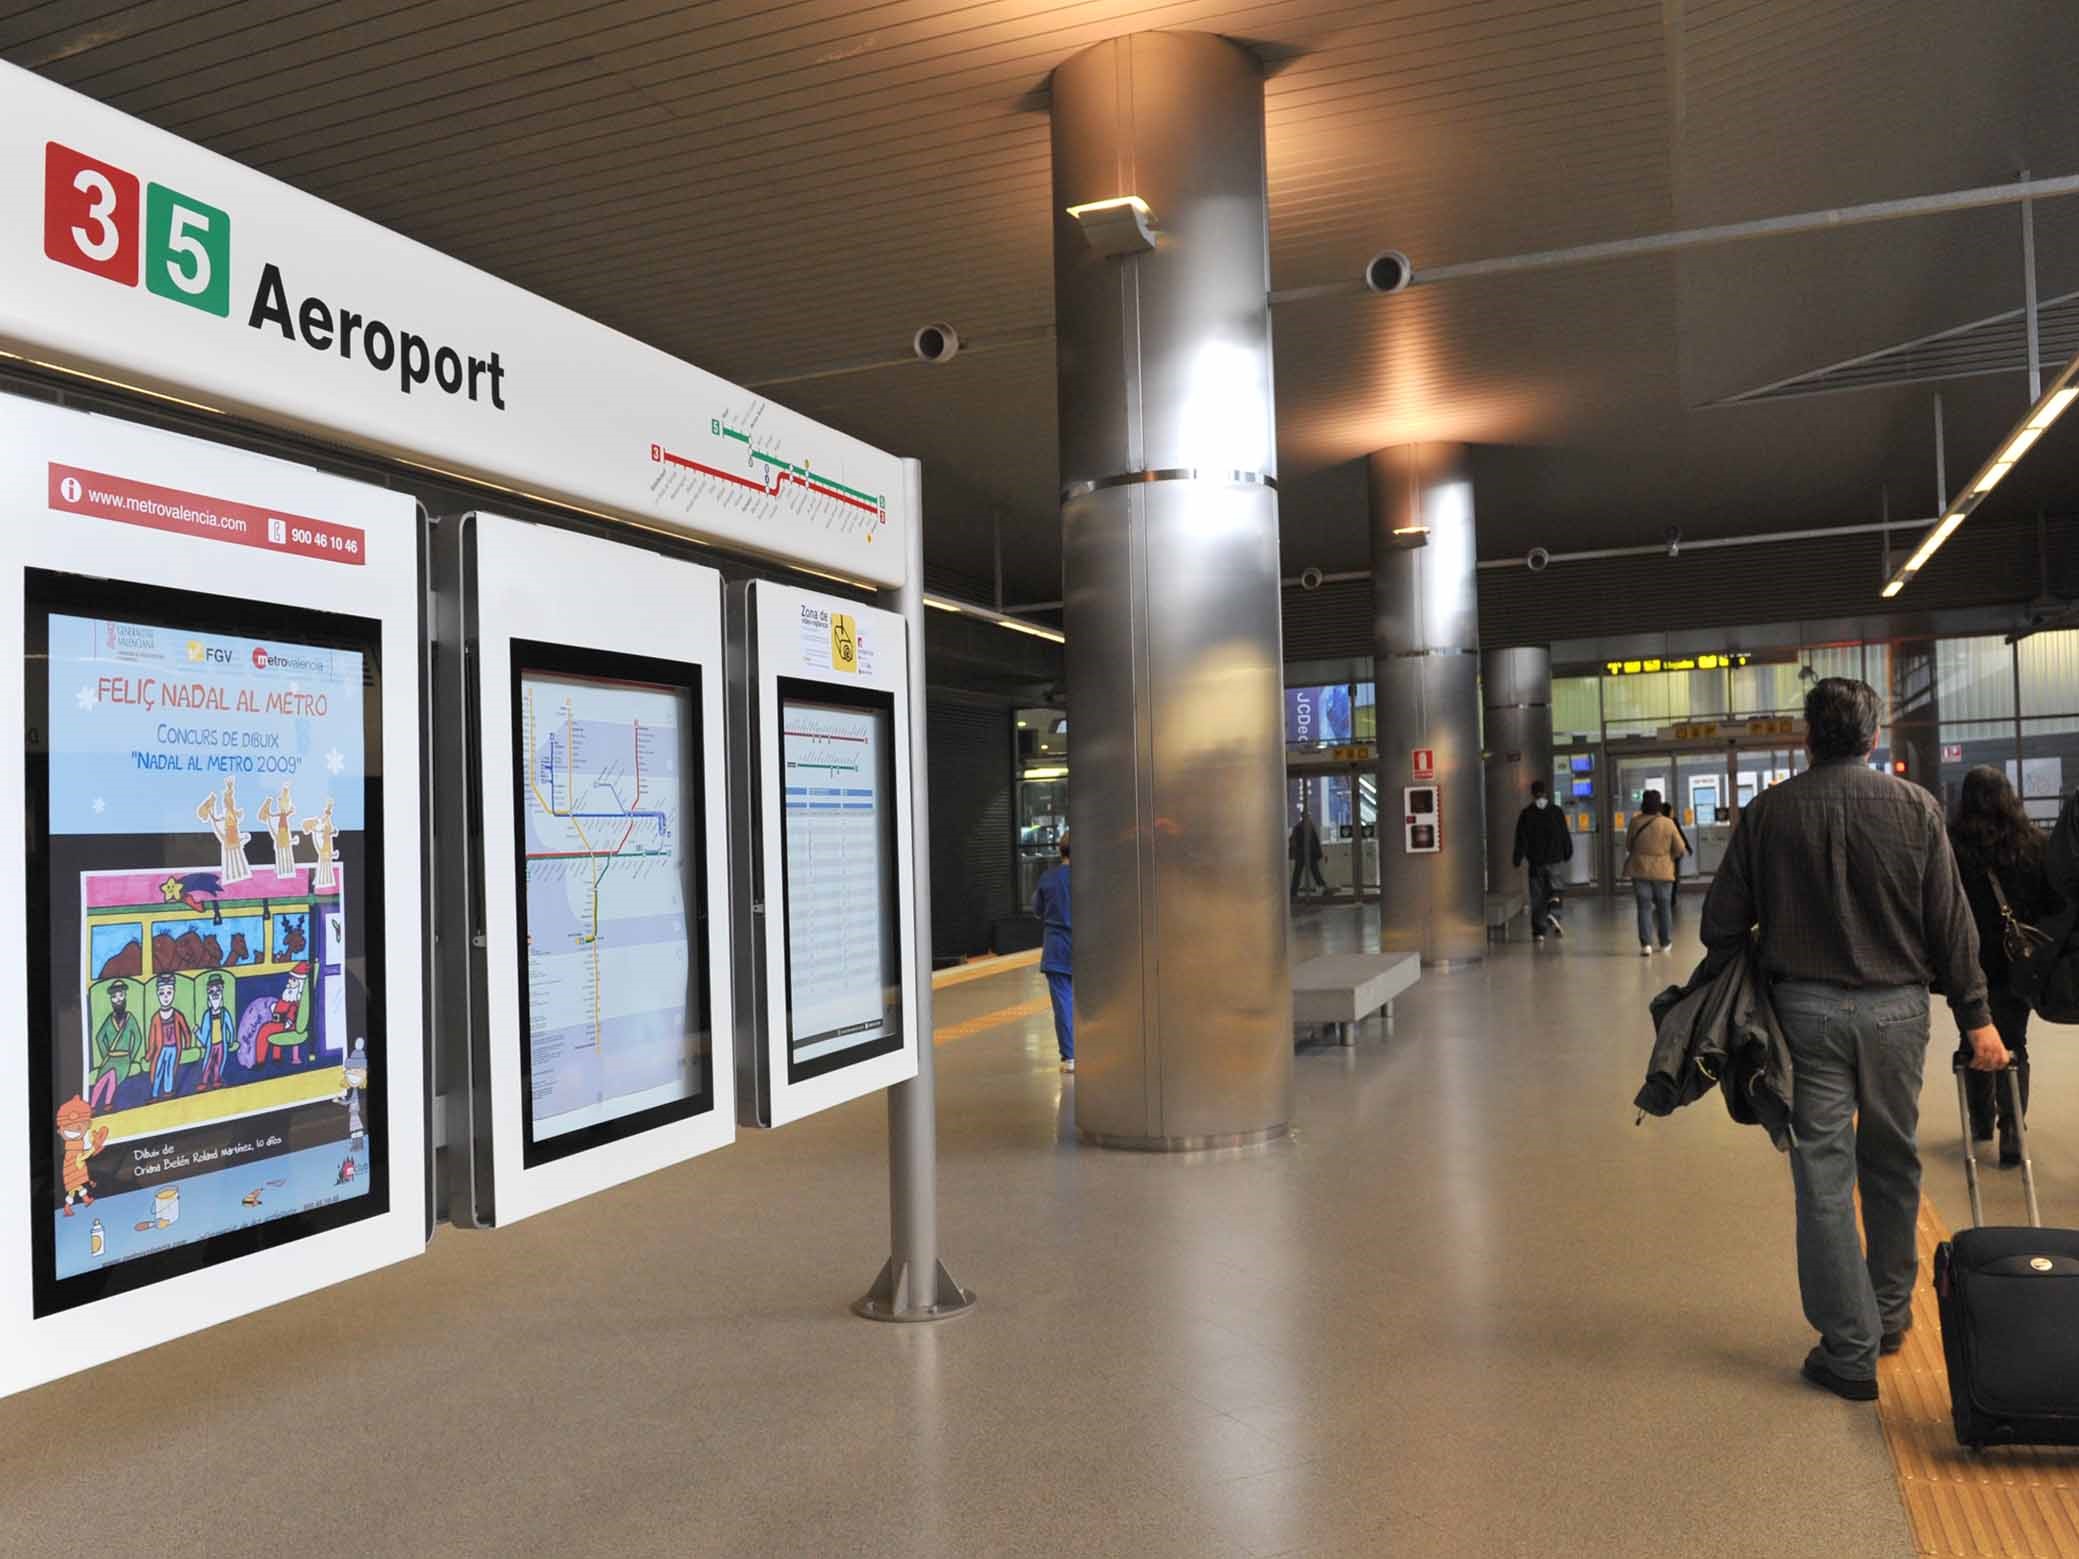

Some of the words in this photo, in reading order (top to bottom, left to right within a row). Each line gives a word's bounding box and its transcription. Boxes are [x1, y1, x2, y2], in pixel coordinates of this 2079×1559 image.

[71, 169, 119, 262] 3
[166, 203, 212, 295] 5
[248, 262, 506, 411] Aeroport
[88, 487, 247, 533] www.metrovalencia.com
[291, 527, 313, 545] 900
[314, 532, 328, 549] 46
[331, 535, 343, 551] 10
[343, 538, 358, 553] 46
[801, 604, 818, 620] Zona
[206, 648, 233, 663] FGV
[98, 677, 156, 711] FELIÇ
[161, 683, 231, 711] NADAL
[236, 689, 260, 712] AL
[187, 756, 203, 771] AL
[207, 755, 254, 772] METRO
[161, 1144, 175, 1157] de
